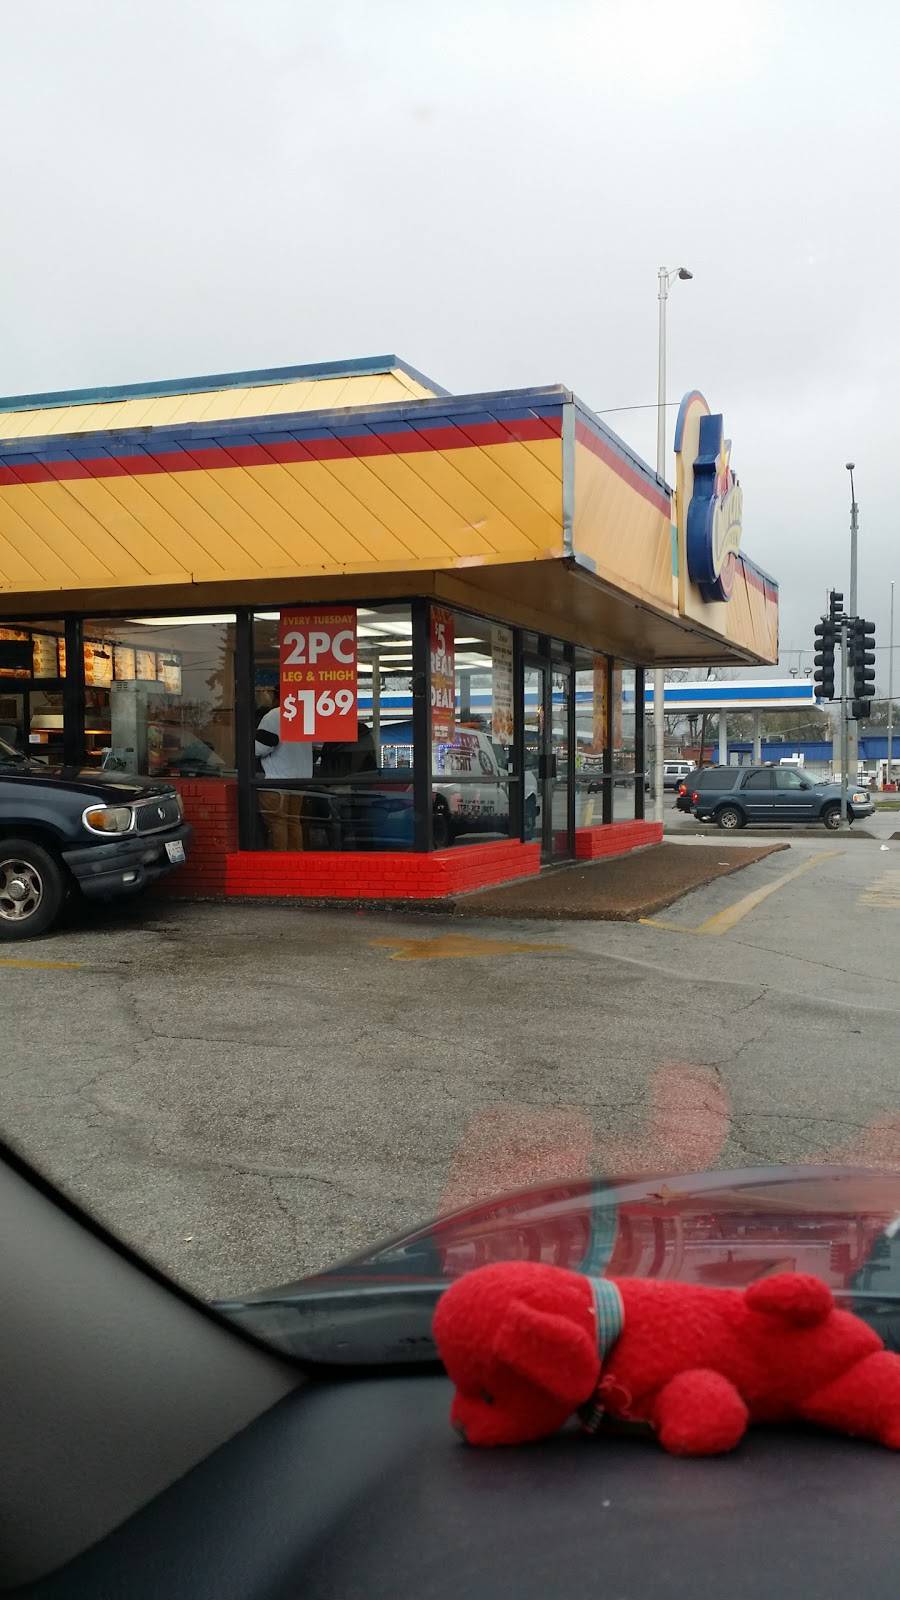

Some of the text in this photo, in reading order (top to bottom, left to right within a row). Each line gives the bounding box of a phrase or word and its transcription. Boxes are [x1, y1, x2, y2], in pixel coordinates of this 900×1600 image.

[283, 615, 353, 626] EVERY TUESDAY
[283, 630, 354, 665] 2PC
[283, 670, 354, 682] LEG & THIGH
[430, 685, 454, 709] DEAL
